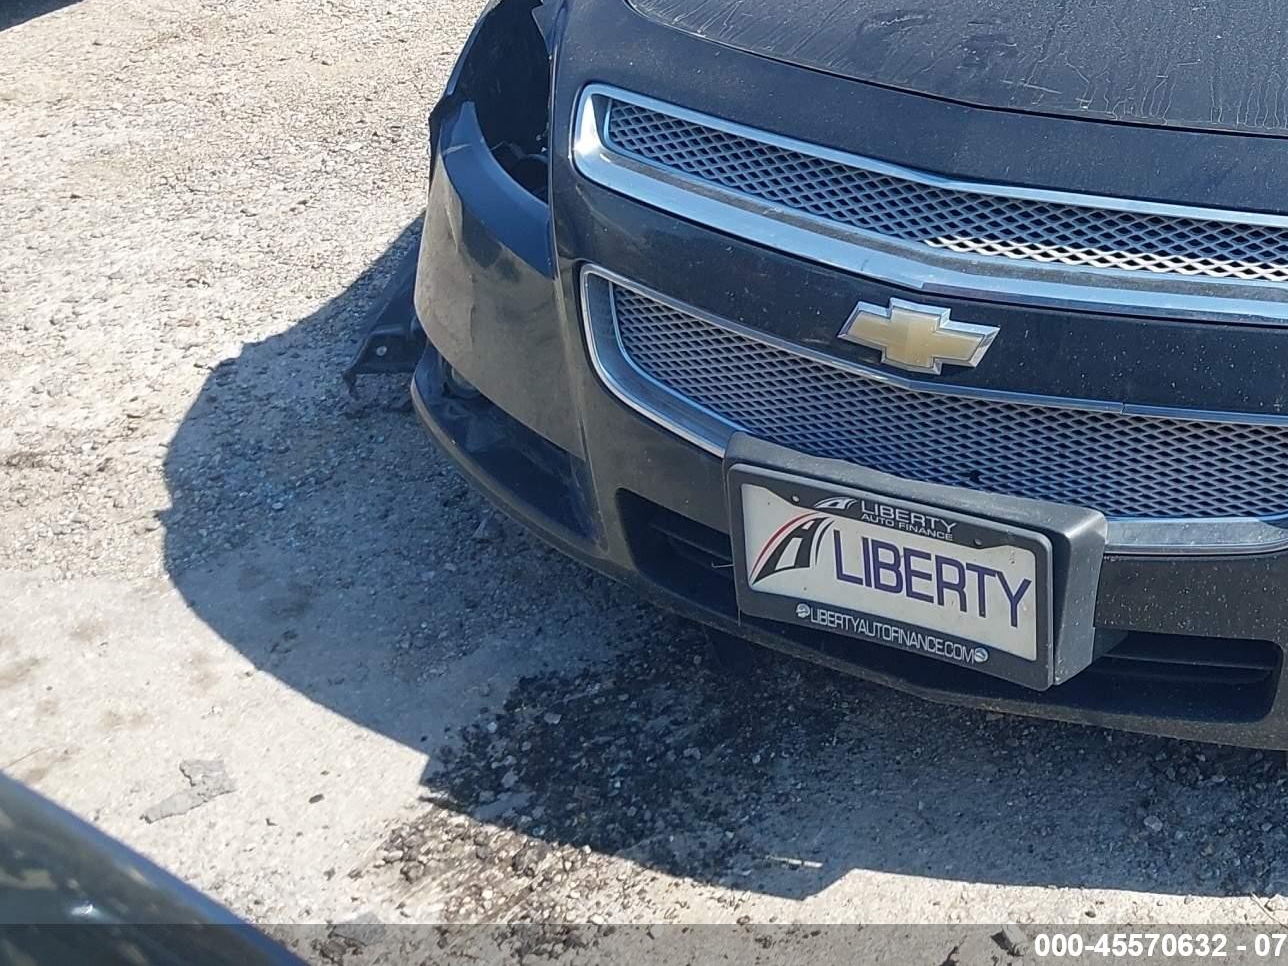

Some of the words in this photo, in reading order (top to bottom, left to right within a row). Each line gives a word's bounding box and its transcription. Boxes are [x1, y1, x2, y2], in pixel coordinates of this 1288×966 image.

[861, 500, 957, 533] LIBERTY
[861, 513, 895, 527] AUTO
[898, 522, 953, 541] FINANCE
[833, 530, 1031, 628] LIBERTY
